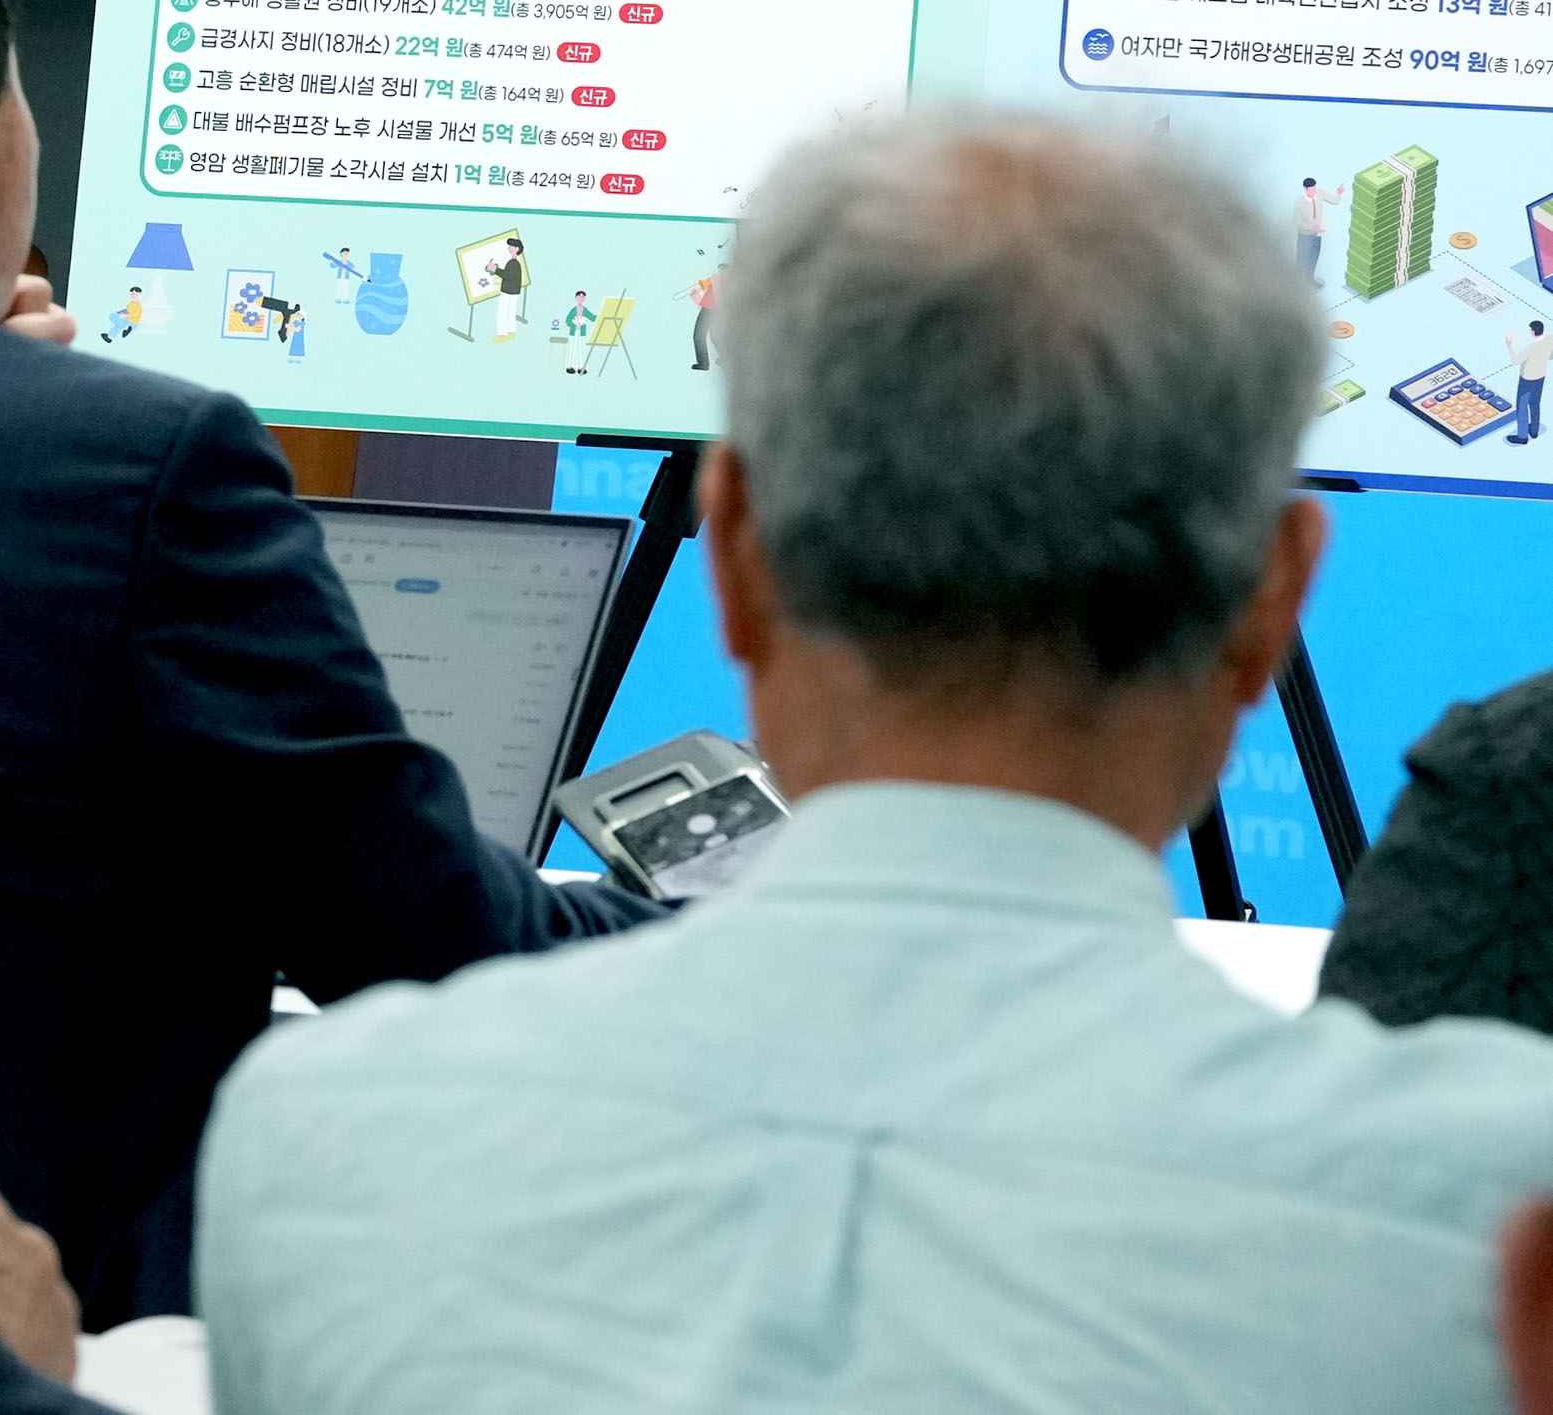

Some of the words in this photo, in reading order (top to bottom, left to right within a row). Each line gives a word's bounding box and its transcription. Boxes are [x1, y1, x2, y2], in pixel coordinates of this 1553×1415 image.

[193, 111, 229, 131] 대불
[235, 112, 329, 135] 배수펌프장
[333, 116, 370, 137] 노후
[376, 119, 432, 140] 시설물
[438, 121, 475, 142] 개선
[482, 123, 513, 143] 5억
[630, 133, 659, 149] 신규
